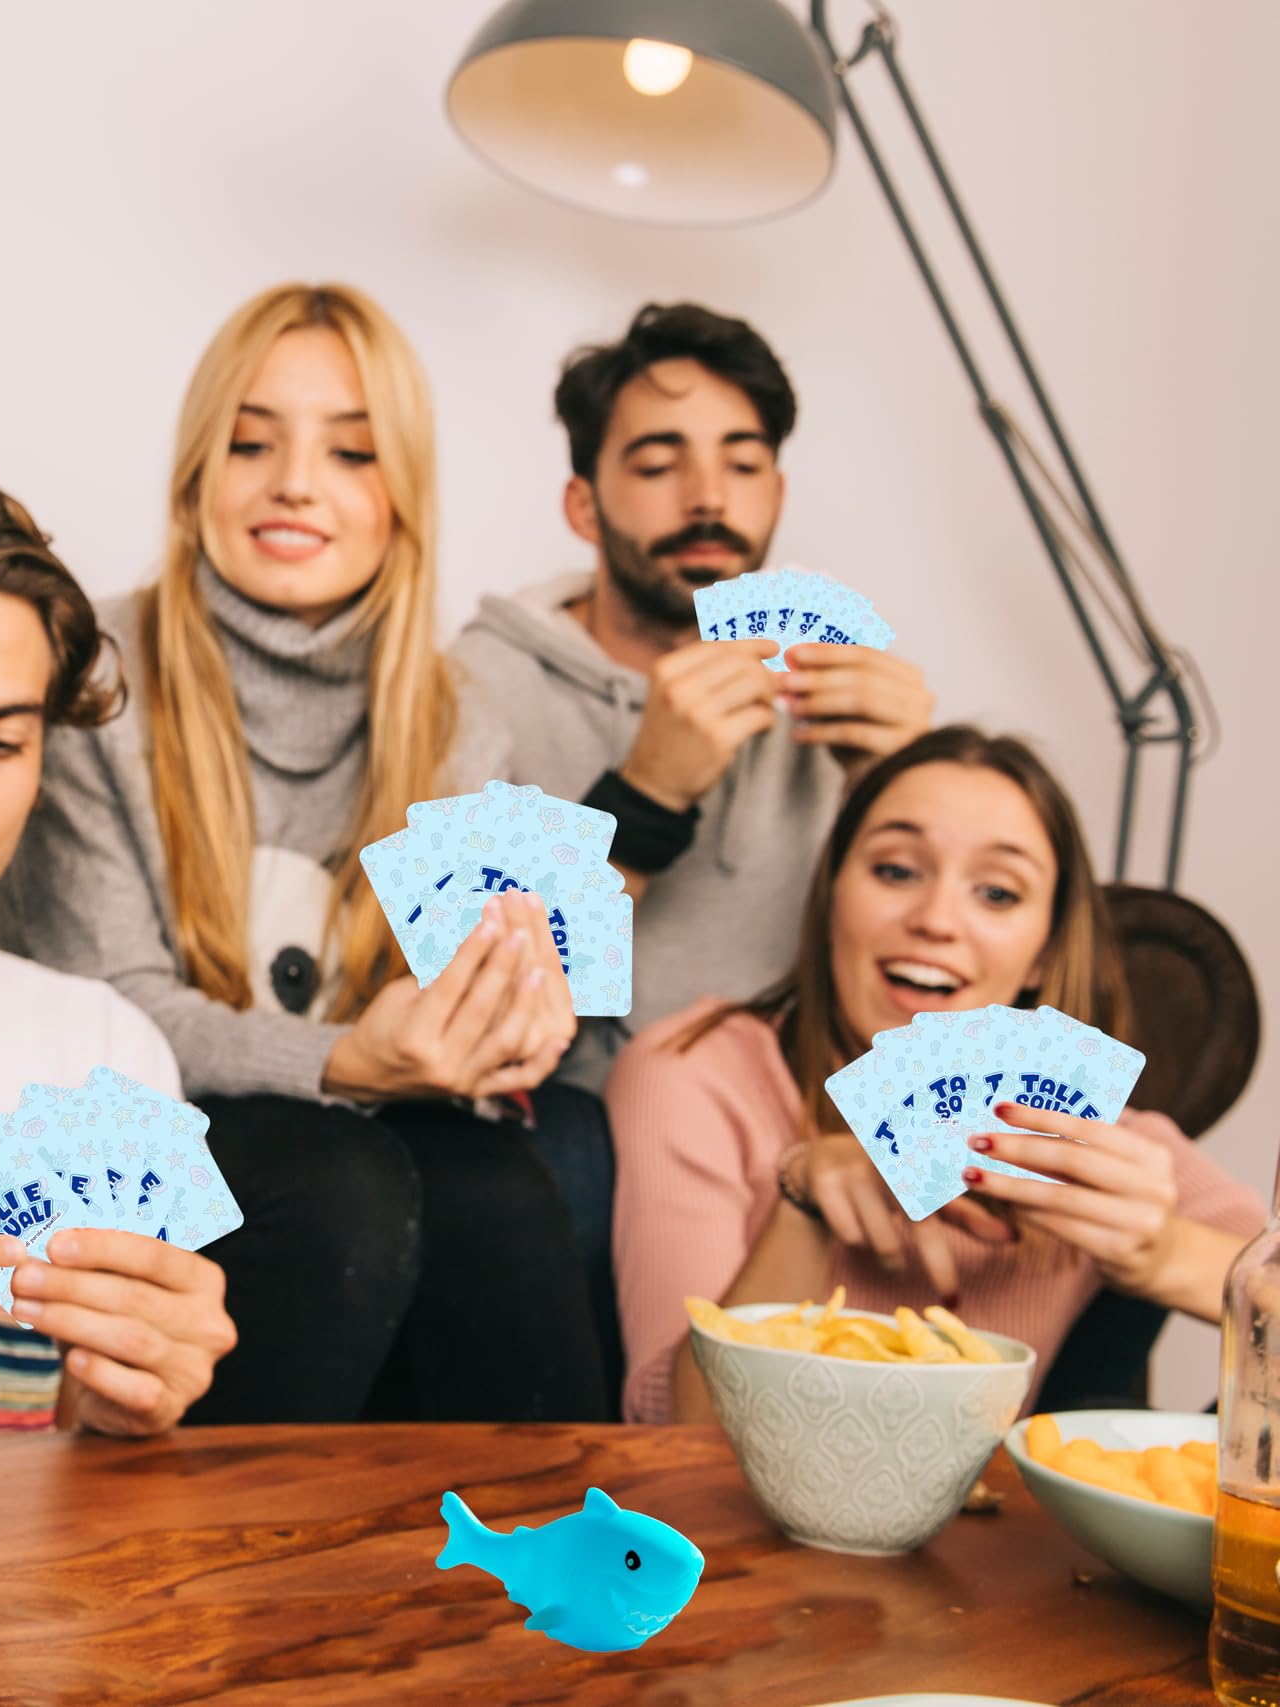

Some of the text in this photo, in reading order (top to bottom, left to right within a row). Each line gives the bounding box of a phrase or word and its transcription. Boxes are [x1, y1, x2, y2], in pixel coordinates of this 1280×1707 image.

[1021, 1074, 1084, 1106] TALI
[23, 1183, 42, 1203] E
[3, 1200, 52, 1237] UALI
